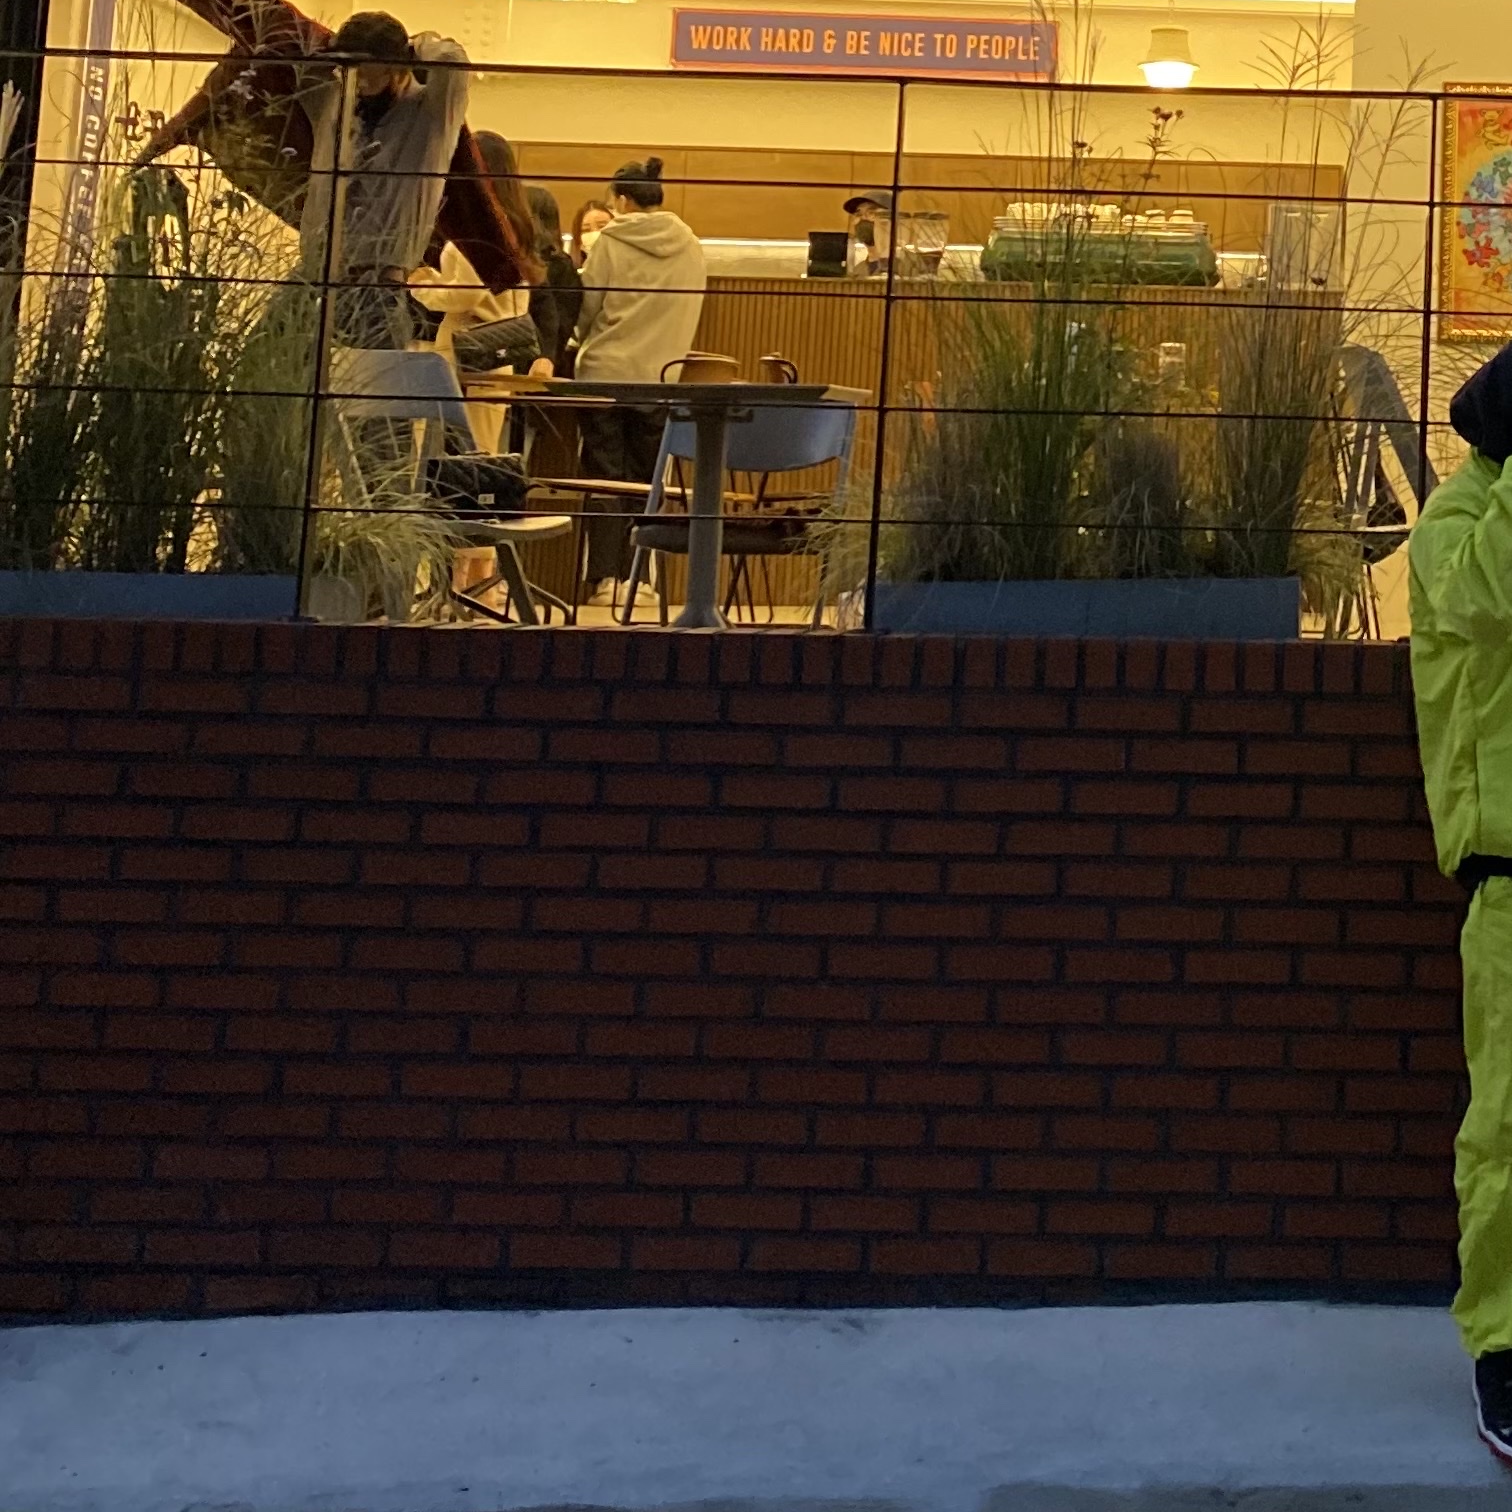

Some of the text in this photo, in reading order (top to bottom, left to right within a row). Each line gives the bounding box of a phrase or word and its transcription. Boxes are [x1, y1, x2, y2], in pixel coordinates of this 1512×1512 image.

[689, 24, 1041, 62] WORK HARD & BE NICE TO PEOPLE
[87, 65, 105, 102] NO
